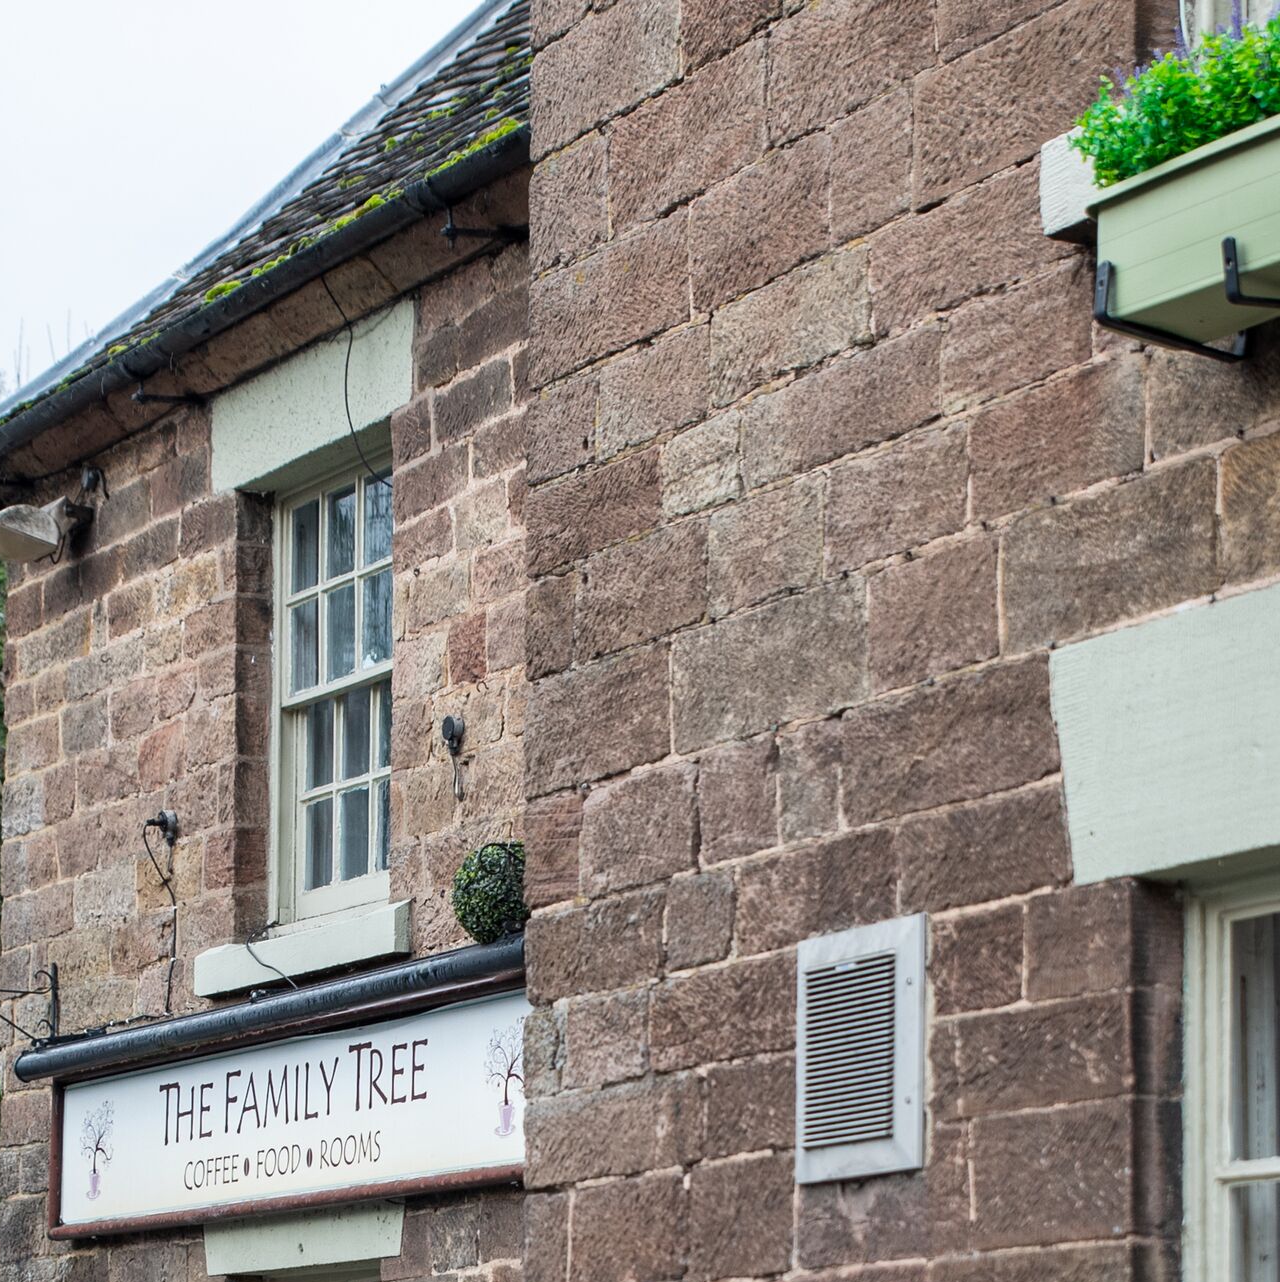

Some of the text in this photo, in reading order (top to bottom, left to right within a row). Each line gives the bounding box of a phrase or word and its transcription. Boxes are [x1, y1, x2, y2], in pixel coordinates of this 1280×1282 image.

[159, 1038, 428, 1146] THE FAMILY TREE
[183, 1130, 382, 1191] COFFEE FOOD ROOMS
